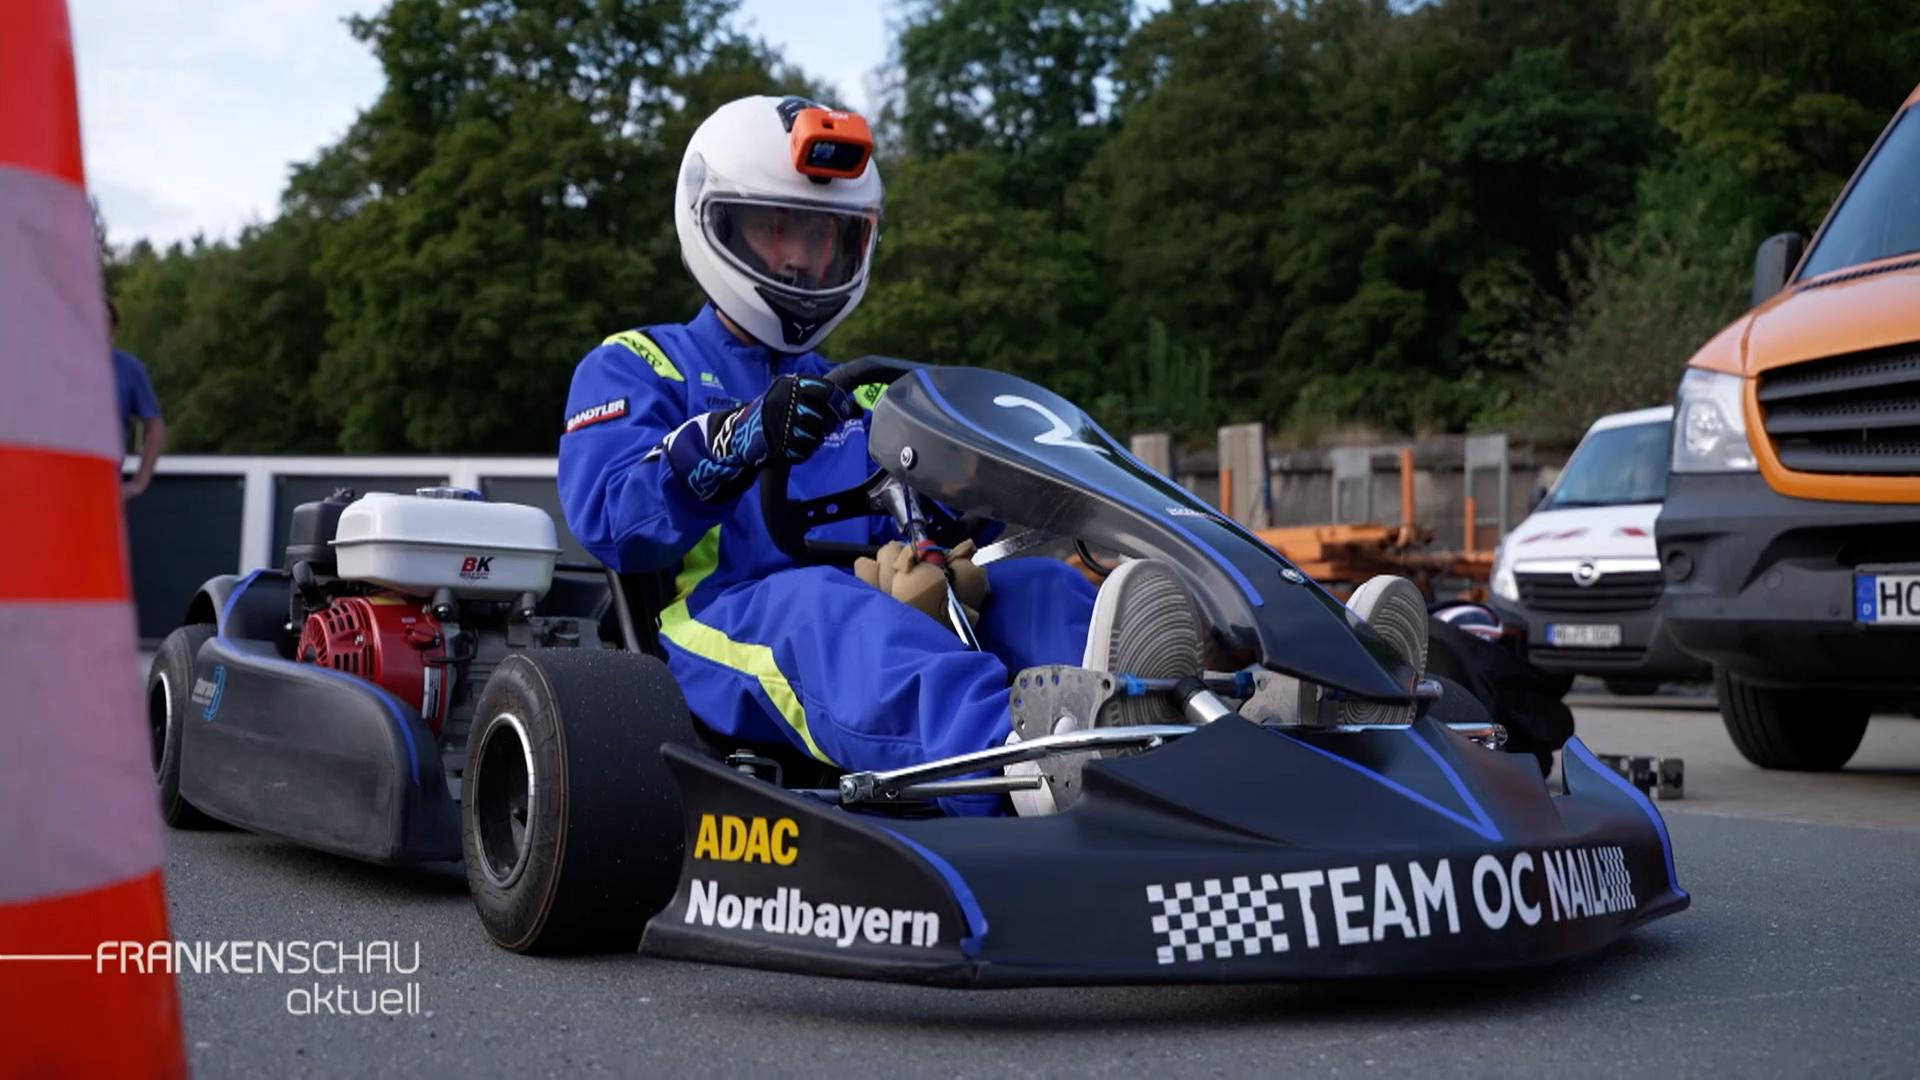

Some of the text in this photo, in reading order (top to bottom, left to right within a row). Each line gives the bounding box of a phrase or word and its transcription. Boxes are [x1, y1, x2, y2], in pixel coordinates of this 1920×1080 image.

[461, 556, 494, 572] BK
[694, 814, 799, 866] ADAC
[684, 879, 940, 948] Nordbayern
[1281, 848, 1614, 948] TEAM OC NAILA
